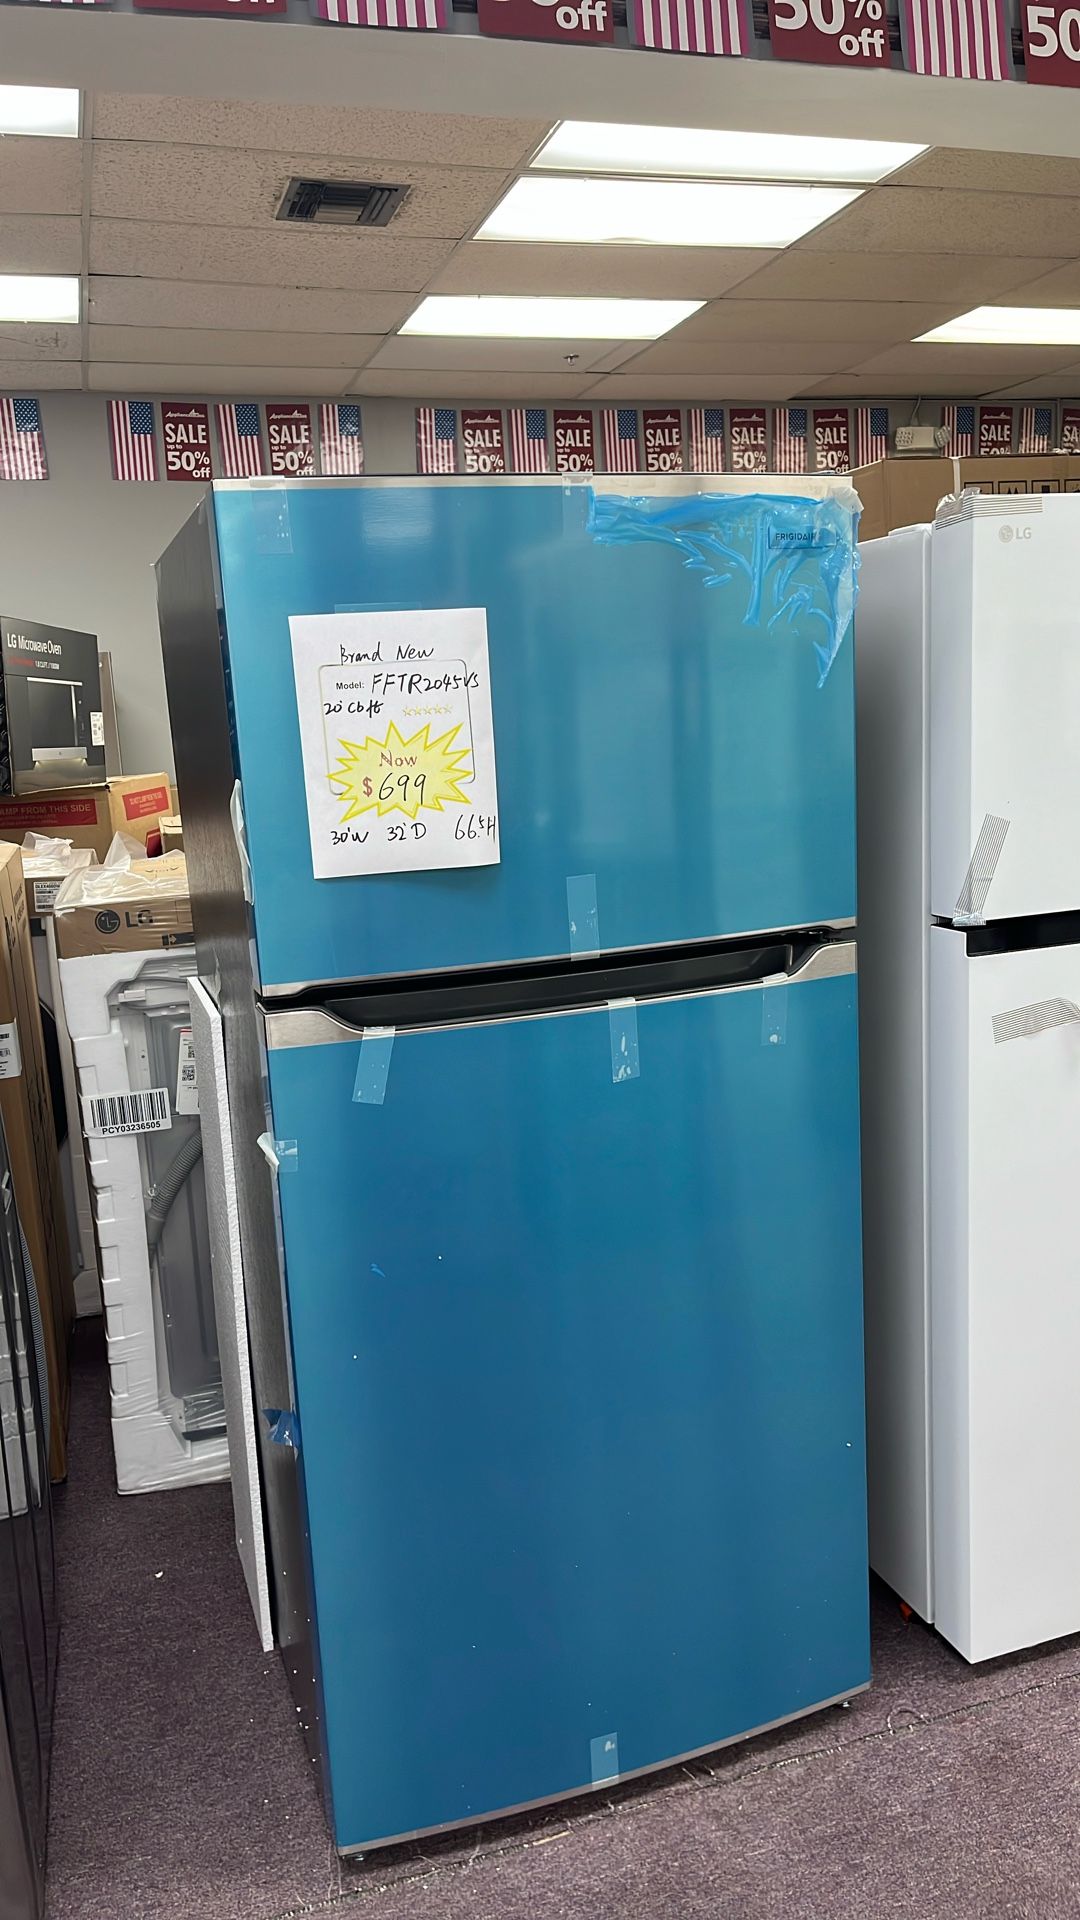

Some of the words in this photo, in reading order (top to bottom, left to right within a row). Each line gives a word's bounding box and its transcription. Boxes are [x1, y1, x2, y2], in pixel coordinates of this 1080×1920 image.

[555, 0, 607, 31] off
[838, 27, 885, 58] off
[165, 423, 207, 444] SALE
[269, 424, 310, 444] SALE
[464, 429, 501, 447] SALE
[556, 429, 591, 447] SALE
[646, 428, 680, 446] SALE
[732, 427, 765, 444] SALE
[815, 426, 847, 445] SALE
[980, 424, 1011, 441] SALE
[167, 451, 210, 470] 50%
[271, 451, 313, 471] 50%
[466, 454, 504, 473] 50%
[557, 454, 593, 472] 50%
[647, 452, 682, 471] 50%
[732, 451, 767, 469] 50%
[816, 450, 849, 469] 50%
[192, 467, 211, 478] off
[296, 466, 314, 476] off
[775, 532, 818, 541] FRIGIDAIR
[1015, 527, 1032, 539] LG
[7, 633, 17, 649] LG
[18, 635, 47, 653] Microwave
[47, 640, 62, 655] Oven
[340, 641, 383, 666] Brand
[396, 644, 434, 661] New
[336, 681, 365, 690] Model:
[371, 671, 479, 695] FFTR2045VS
[379, 750, 418, 767] Now
[20, 806, 47, 814] FROM
[48, 805, 68, 813] THIS
[70, 804, 91, 812] SIDE
[125, 909, 154, 928] LG
[102, 1121, 161, 1135] PCY03236505
